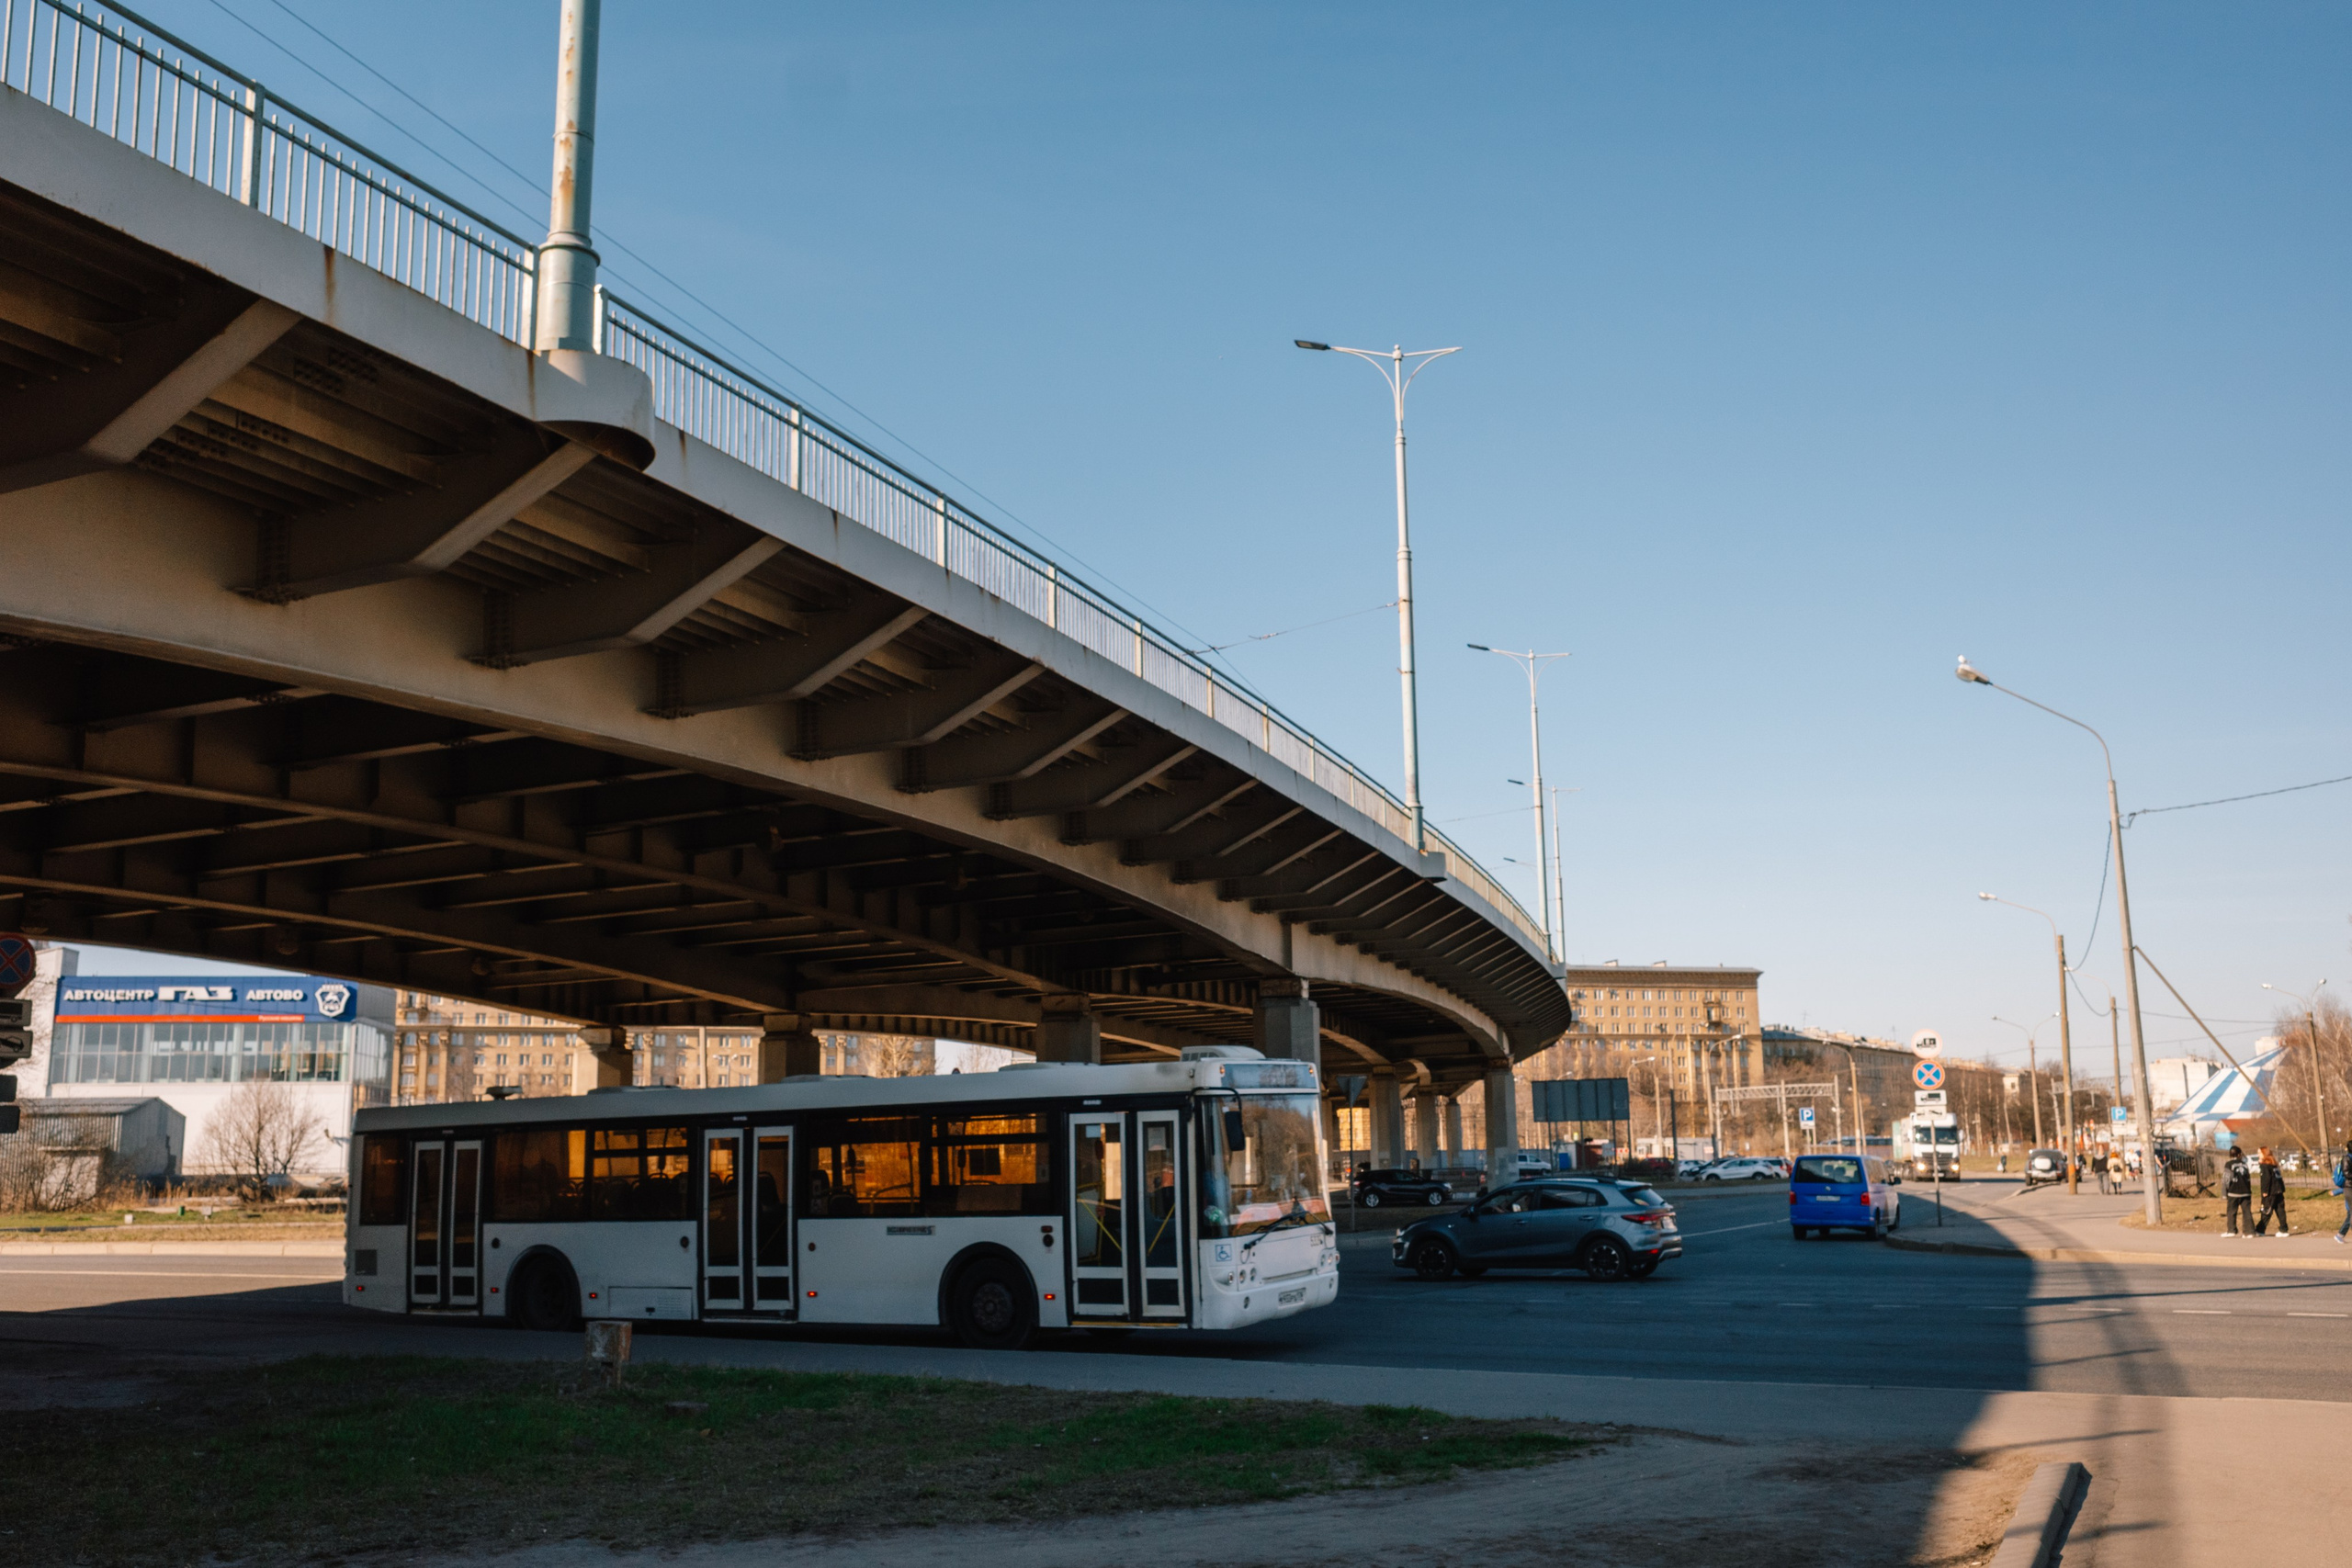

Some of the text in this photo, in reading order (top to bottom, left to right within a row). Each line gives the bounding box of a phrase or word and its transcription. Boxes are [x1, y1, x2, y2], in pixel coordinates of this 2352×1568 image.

[63, 987, 304, 1002] АВТОЦЕНТР ГАЗ АВТОВО
[1804, 1110, 1812, 1121] P
[2115, 1108, 2124, 1120] P
